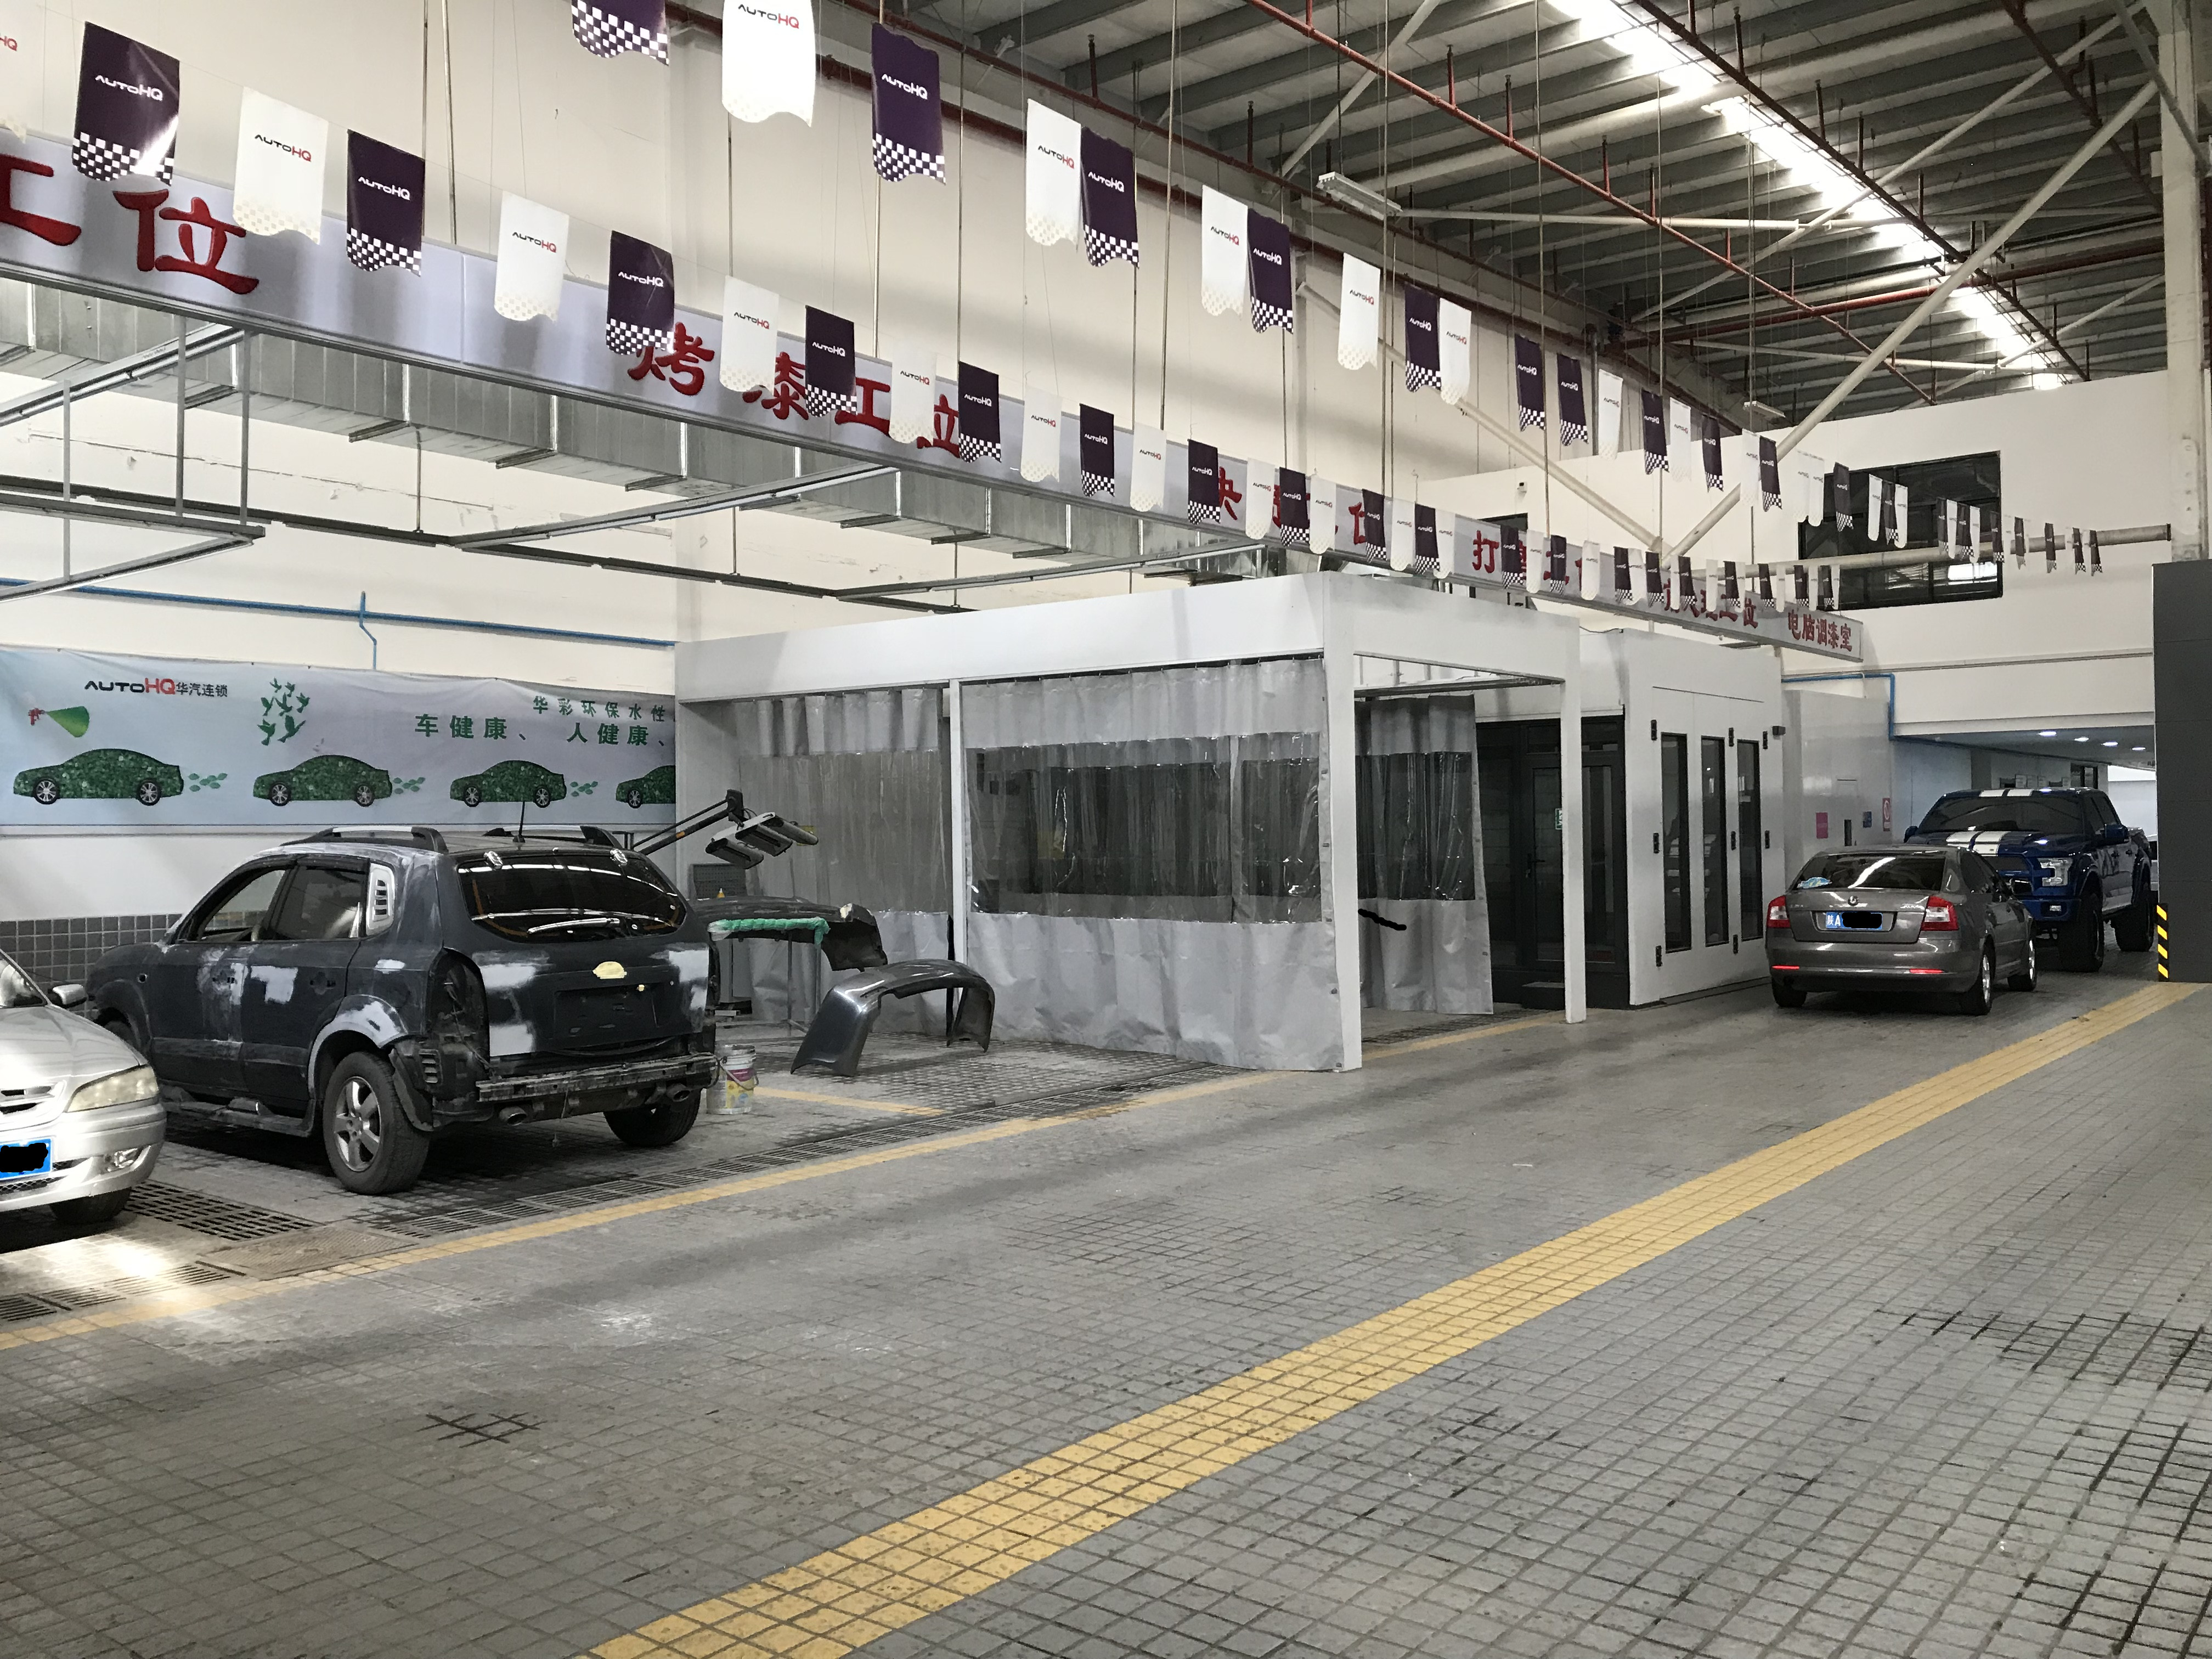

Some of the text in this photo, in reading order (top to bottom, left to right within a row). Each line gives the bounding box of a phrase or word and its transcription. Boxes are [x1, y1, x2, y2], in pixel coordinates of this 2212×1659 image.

[738, 4, 799, 29] AUTOHQ
[95, 74, 163, 101] AUTOHQ
[882, 74, 928, 100] AUTOHQ
[254, 134, 312, 162] AUTOHQ
[1038, 145, 1074, 168] AUTOHQ
[358, 176, 410, 200] AUTOHQ
[1088, 171, 1125, 193] AUTOHQ
[512, 232, 556, 253] AUTOHQ
[1210, 225, 1239, 246] AUTOHQ
[1253, 247, 1282, 265] AUTOHQ
[618, 271, 663, 287] AUTOHQ
[733, 312, 770, 330] AUTOHQ
[812, 342, 845, 357] AUTOHQ
[900, 370, 930, 385] AUTOHQ
[964, 394, 992, 407] AUTOHQ
[533, 696, 675, 722] 华彩环保水性
